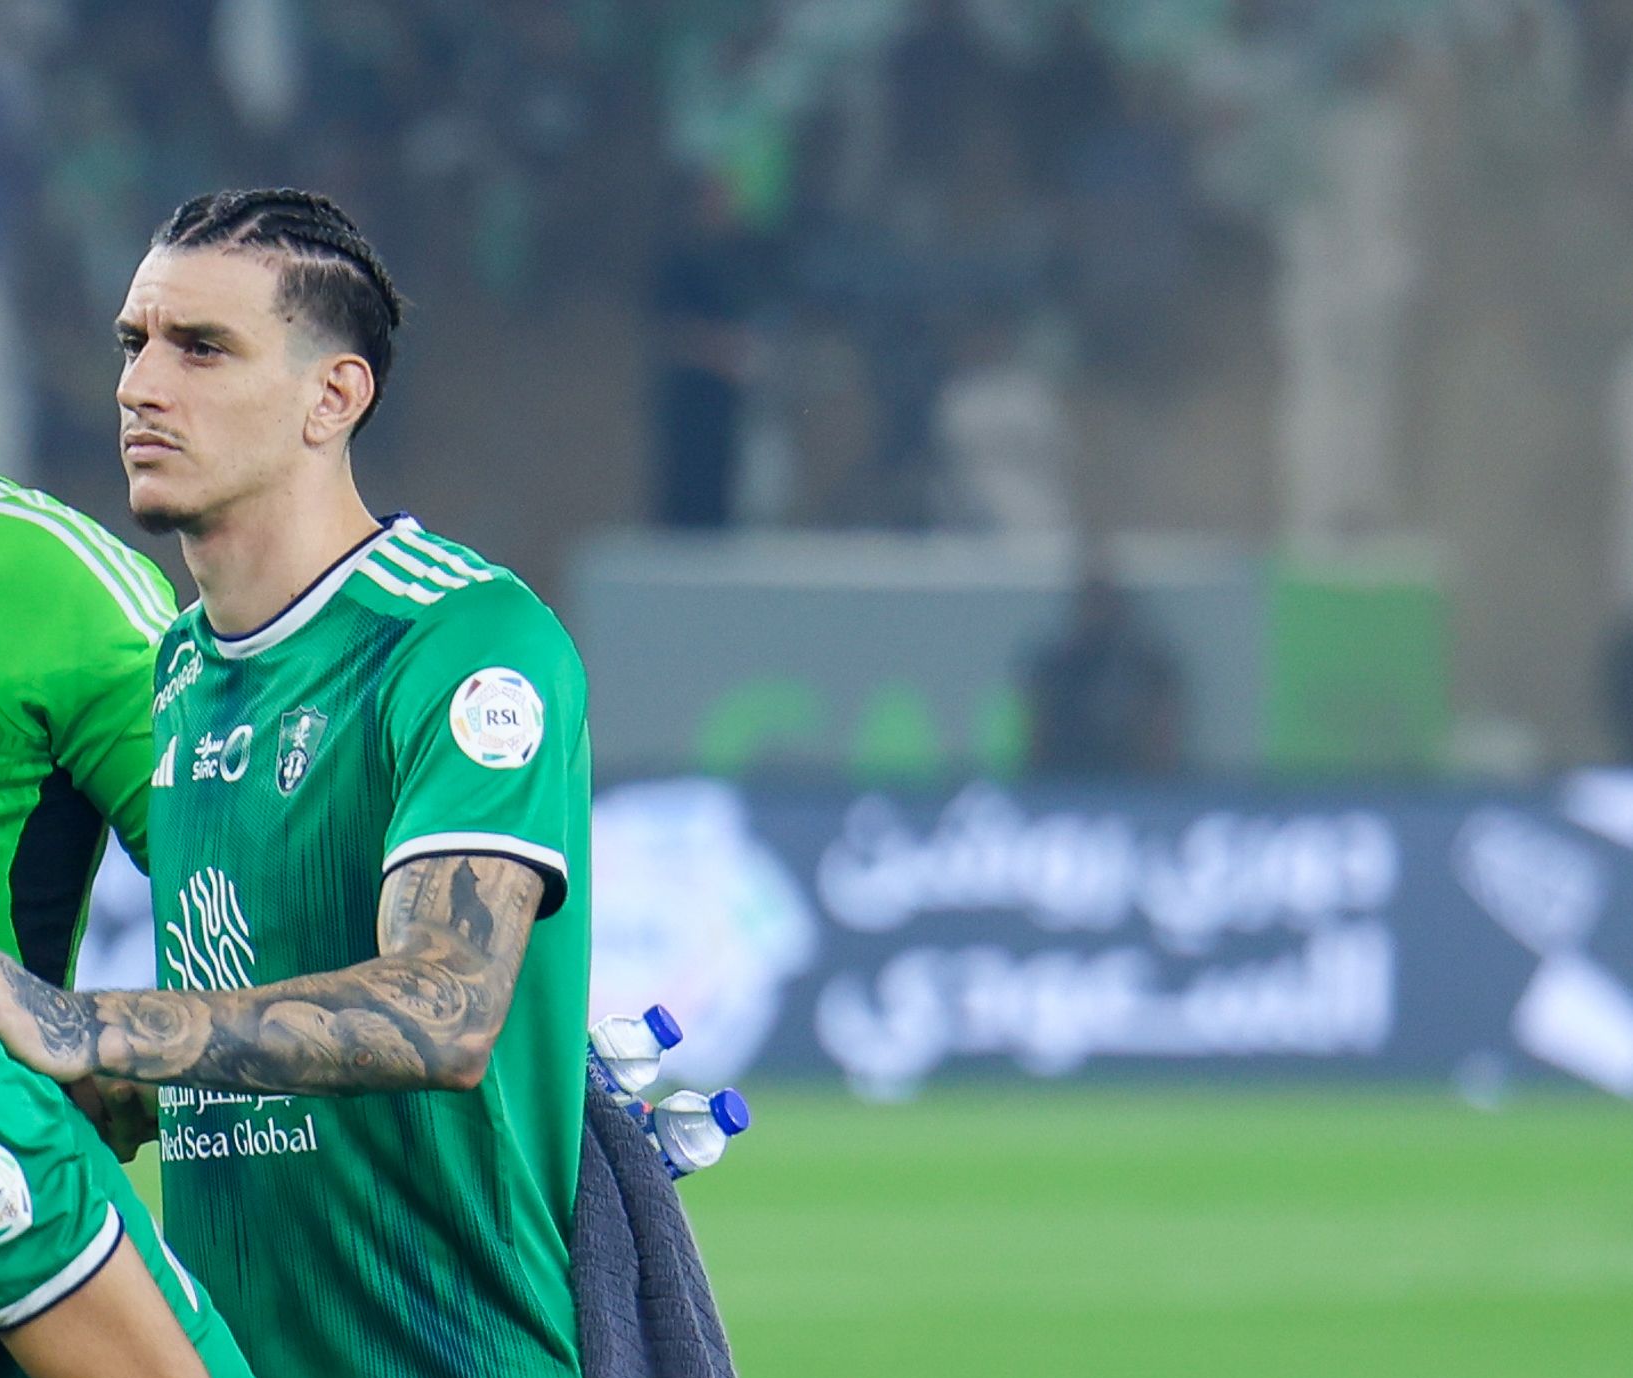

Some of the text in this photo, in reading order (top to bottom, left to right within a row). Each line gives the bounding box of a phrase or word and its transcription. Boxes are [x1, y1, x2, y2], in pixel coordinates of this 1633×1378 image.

[486, 709, 520, 726] RSL
[191, 758, 219, 781] SIRC
[160, 1113, 318, 1162] Red Sea Global
